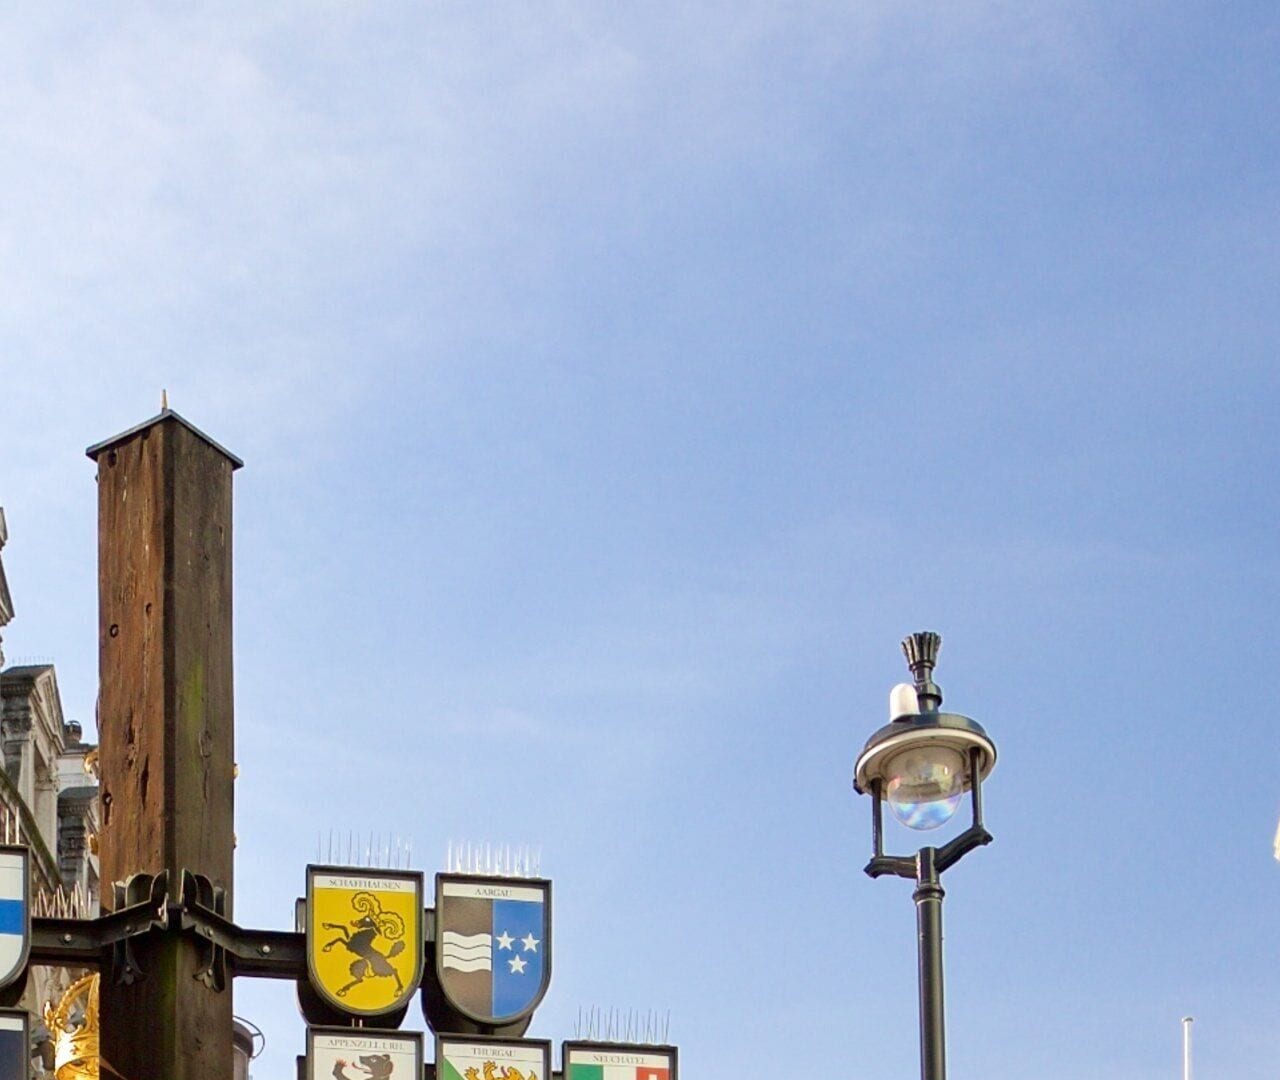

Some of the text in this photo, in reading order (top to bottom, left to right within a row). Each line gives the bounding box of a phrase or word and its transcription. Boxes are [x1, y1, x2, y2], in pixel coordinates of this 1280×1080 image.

[329, 878, 401, 890] SCHAFFHAUSEN
[474, 887, 512, 899] AARGAU
[472, 1047, 517, 1058] THURGAU
